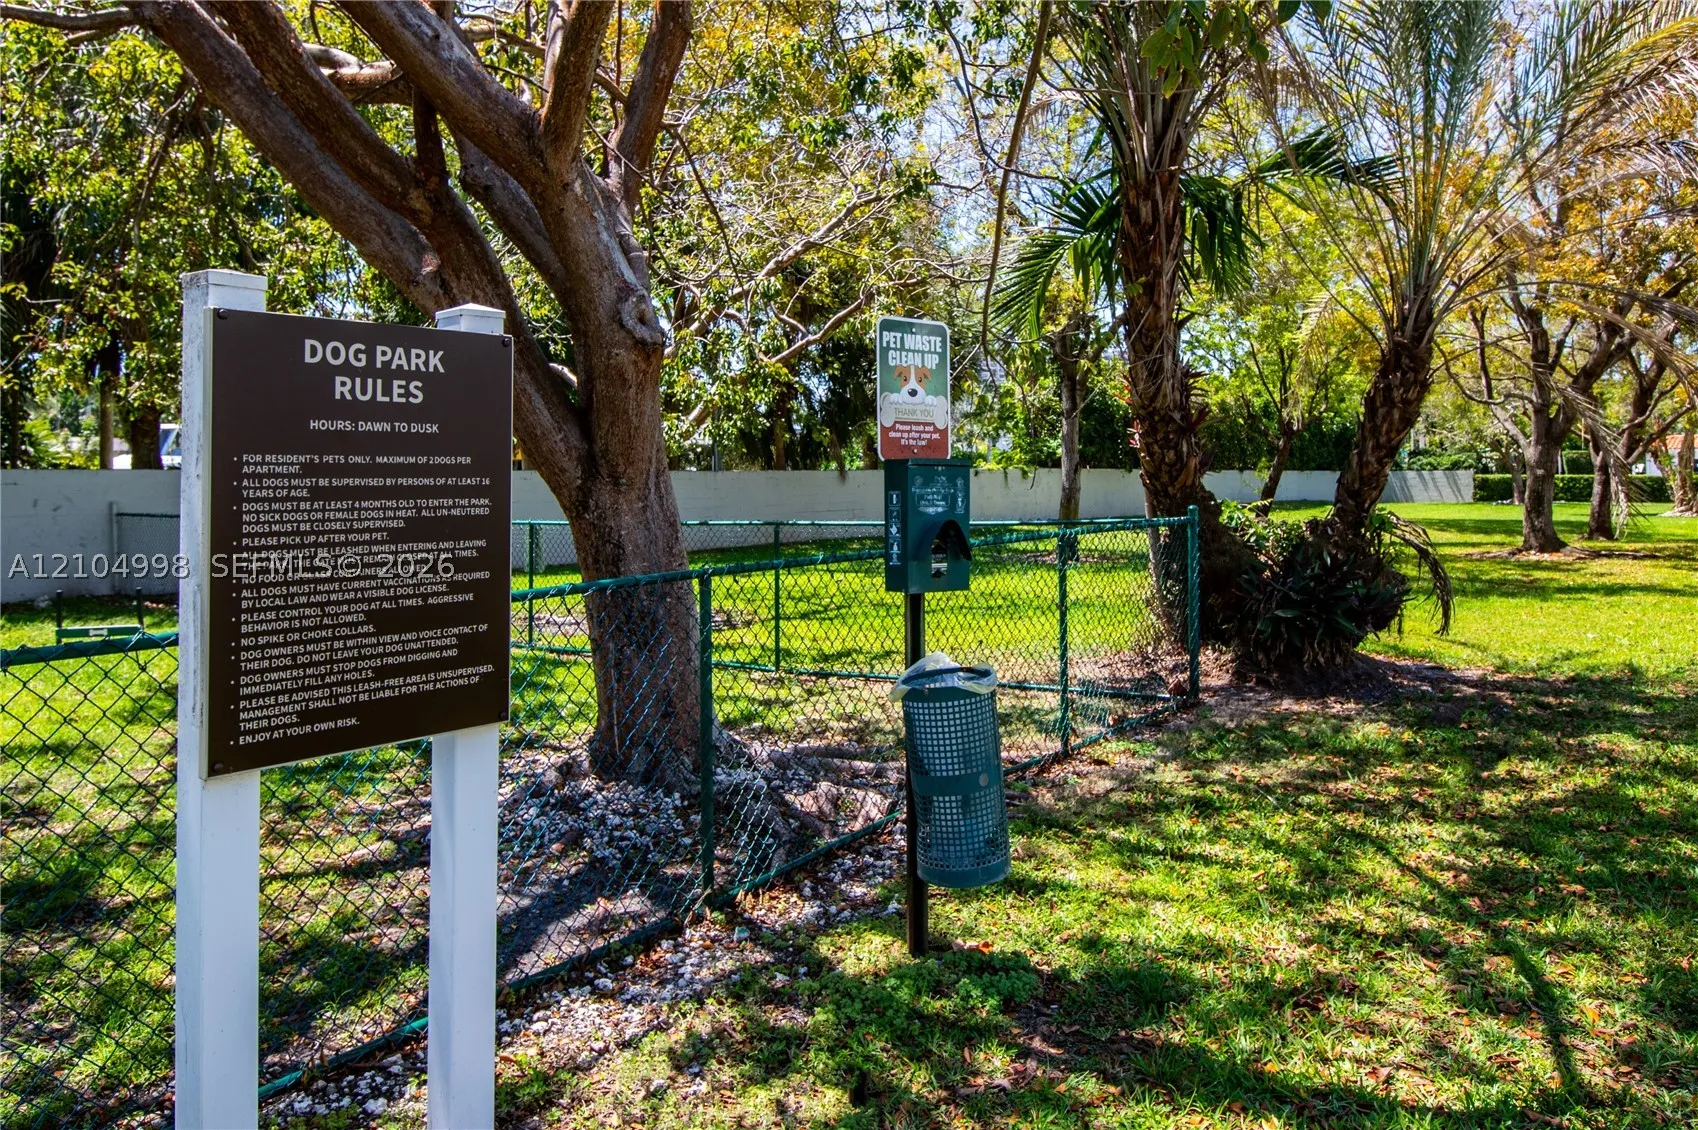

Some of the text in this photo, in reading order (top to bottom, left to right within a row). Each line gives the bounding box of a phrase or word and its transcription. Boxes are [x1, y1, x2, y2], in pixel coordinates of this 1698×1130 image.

[883, 331, 942, 352] PET WASTE
[304, 338, 444, 372] DOG PARK
[888, 351, 939, 369] CLEAN UP
[334, 376, 423, 403] RULES
[894, 408, 934, 417] THANK YOU
[310, 419, 438, 433] HOURS: DAWN TO DUSK
[242, 454, 262, 463] FOR
[322, 455, 344, 463] PETS
[348, 455, 372, 463] ONLY.
[375, 455, 415, 463] MAXIMUM
[242, 465, 302, 473] APARTMENT.
[242, 478, 260, 487] ALL
[262, 478, 289, 487] DOGS
[290, 478, 316, 486] MUST
[318, 478, 329, 486] BE
[331, 477, 384, 486] SUPERVISED
[385, 477, 396, 485] BY
[397, 477, 434, 485] PERSONS
[242, 488, 310, 497] YEARS OF AGE.
[242, 502, 269, 511] DOGS
[271, 501, 298, 510] MUST
[299, 501, 310, 510] BE
[312, 501, 324, 509] AT
[325, 500, 352, 509] LEAST
[353, 500, 359, 508] 4
[360, 499, 397, 508] MONTHS
[398, 499, 414, 507] OLD
[428, 498, 453, 506] ENTER
[242, 506, 489, 522] NO SICK DOGS OR FEMALE DOGS IN HEAT. ALL UN-NEUTERED
[242, 519, 405, 533] DOGS MUST BE CLOSELY SUPERVISED.
[242, 532, 389, 546] PLEASE PICK UP AFTER YOUR PET.
[241, 571, 490, 598] ALL DOGS MUST HAVE CURRENT REQUIRED
[241, 583, 449, 608] BY LOCAL LAW AND WEAR A VISIBLE DOG LICENSE.
[240, 593, 473, 622] PLEASE CONTROL YOUR DOG AT ALL TIMES. AGGRESSIVE
[241, 612, 366, 633] BEHAVIOR IS NOT ALLOWED.
[240, 623, 487, 660] DOG OWNERS MUST BE WITHIN VIEW AND VOICE CONTACT OF
[240, 636, 458, 670] THEIR DOG. DO NOT LEAVE YOUR DOG UNATTENDED.
[240, 648, 457, 684] DOG OWNERS MUST STOP DOGS FROM DIGGING AND
[239, 664, 494, 709] PLEASE BE ADVISED THIS LEASH-FREE AREA IS UNSUPERVISED.
[239, 716, 359, 744] ENJOY AT YOUR OWN RISK.
